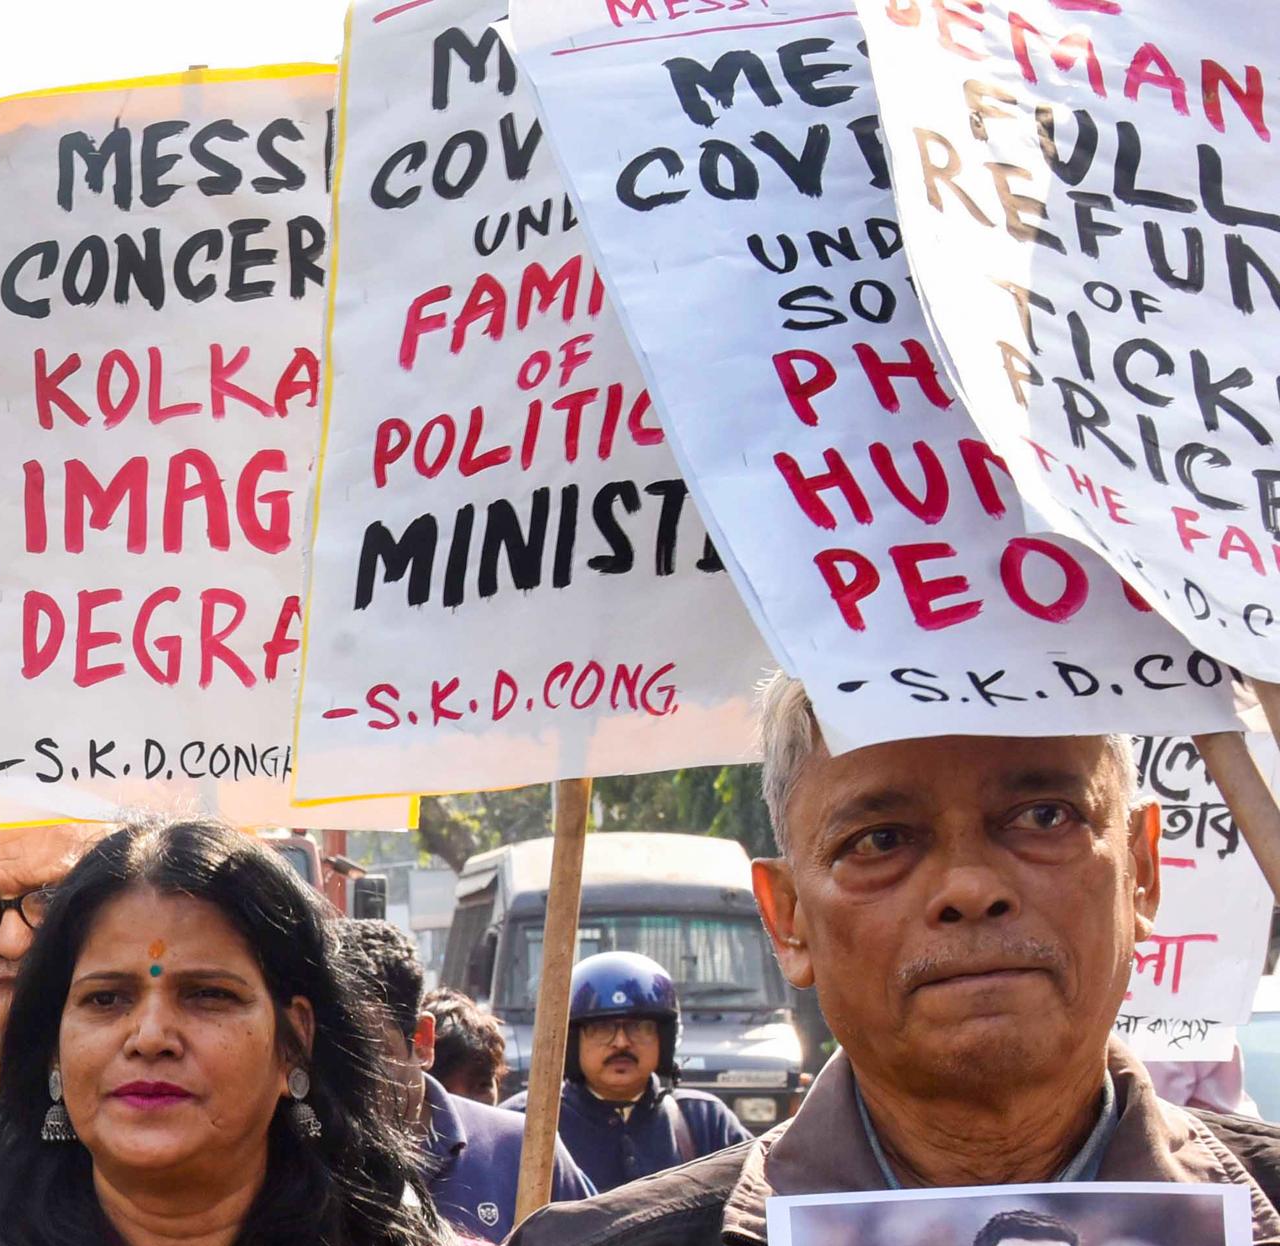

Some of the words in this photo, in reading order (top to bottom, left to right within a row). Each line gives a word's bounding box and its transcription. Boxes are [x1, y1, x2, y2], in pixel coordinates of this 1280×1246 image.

[371, 112, 543, 210] COV
[1, 215, 326, 319] CONCER
[746, 217, 903, 275] UND
[912, 127, 1280, 316] REFUN
[400, 255, 605, 371] FAMI
[1082, 281, 1163, 324] OF
[34, 343, 321, 430] KOLKA
[517, 332, 593, 390] OF
[772, 338, 957, 427] PH
[991, 276, 1280, 447] TICK
[372, 383, 665, 489] POLITIC
[23, 448, 292, 555] IMAG
[21, 587, 302, 690] DEGRA
